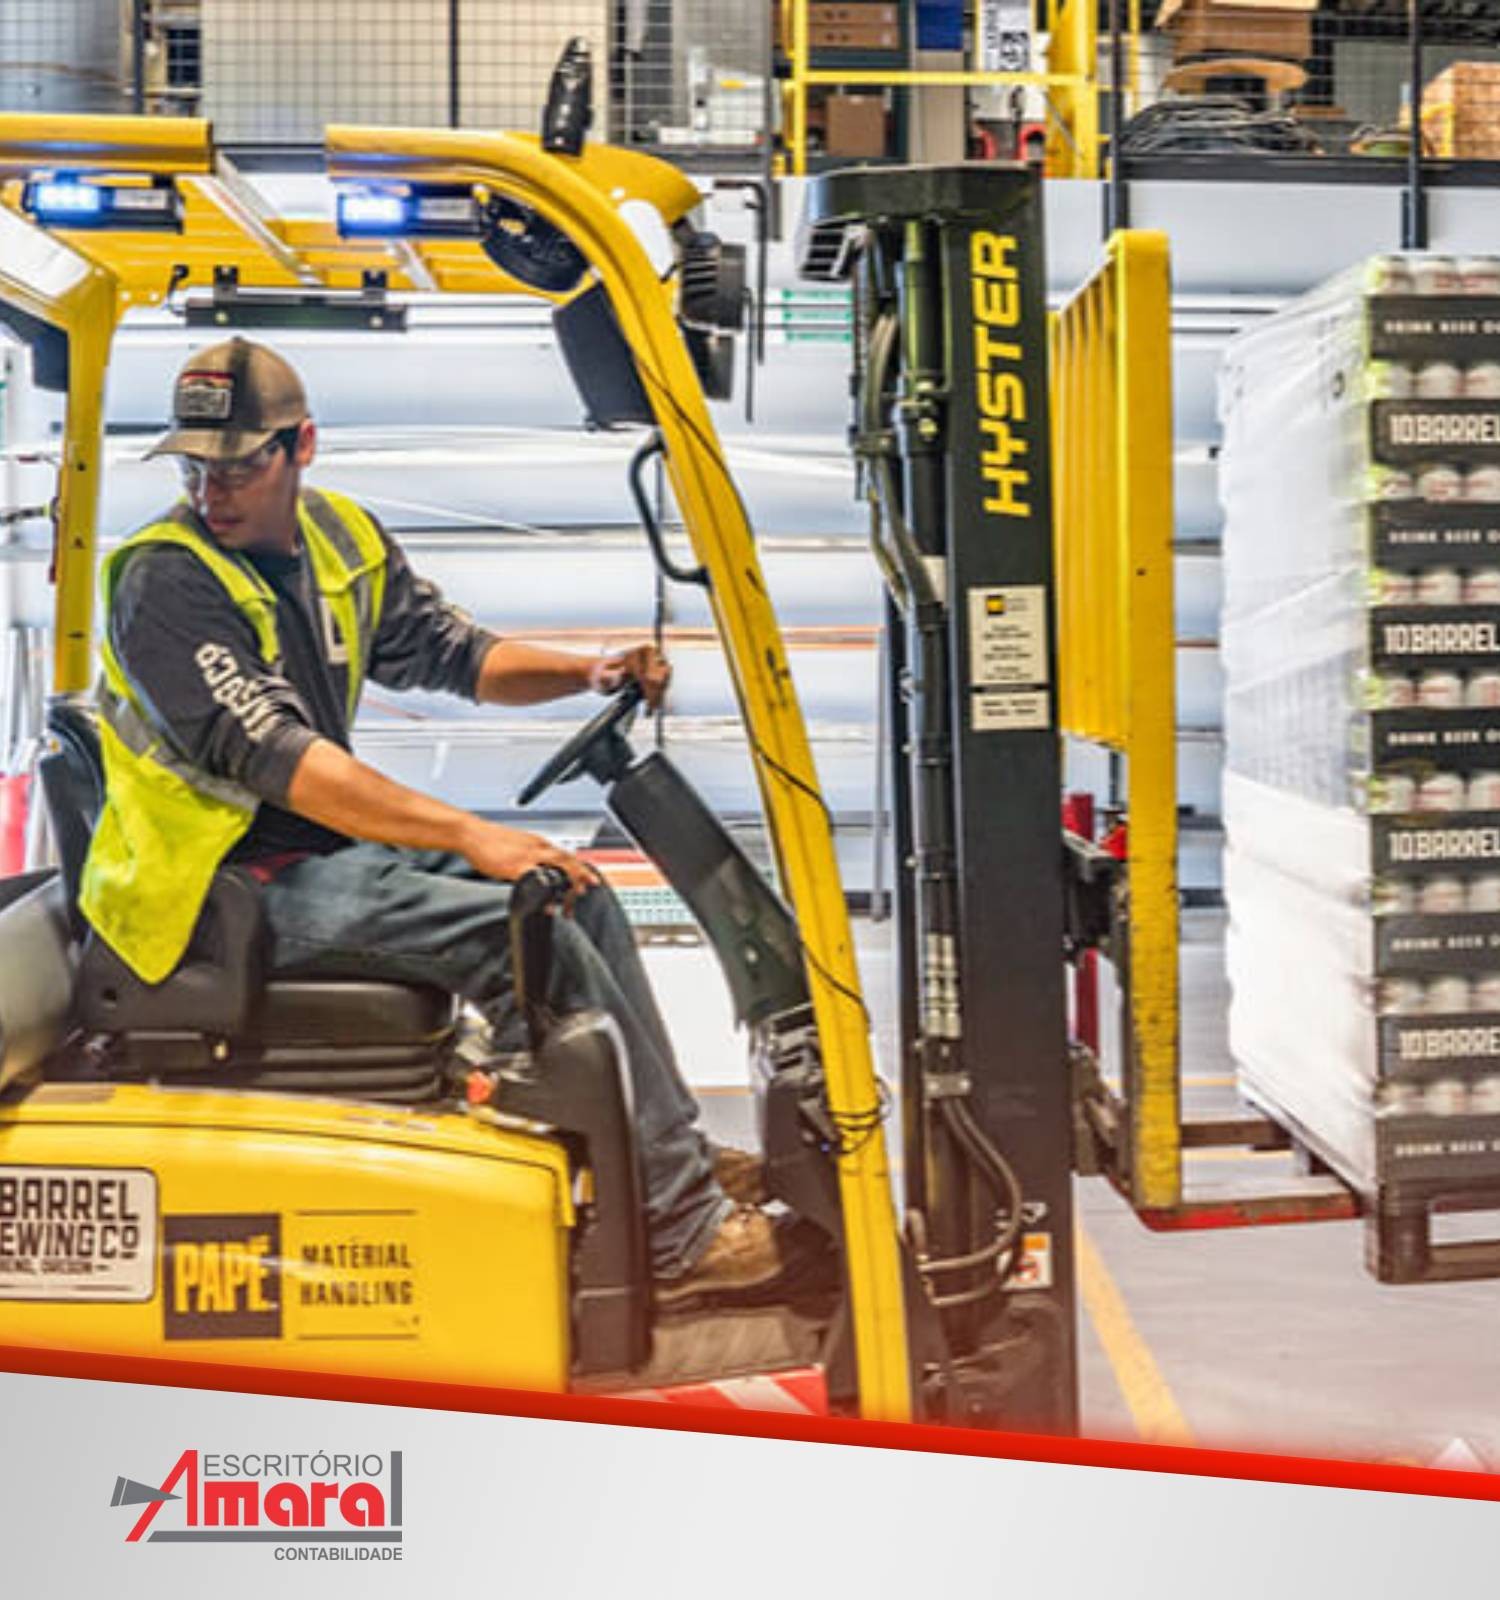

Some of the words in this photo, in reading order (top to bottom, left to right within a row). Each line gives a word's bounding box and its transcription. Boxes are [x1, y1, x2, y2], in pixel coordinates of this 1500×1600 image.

[971, 231, 1031, 517] HYSTER
[0, 1177, 139, 1222] BARREL
[301, 1280, 412, 1306] HANDLING
